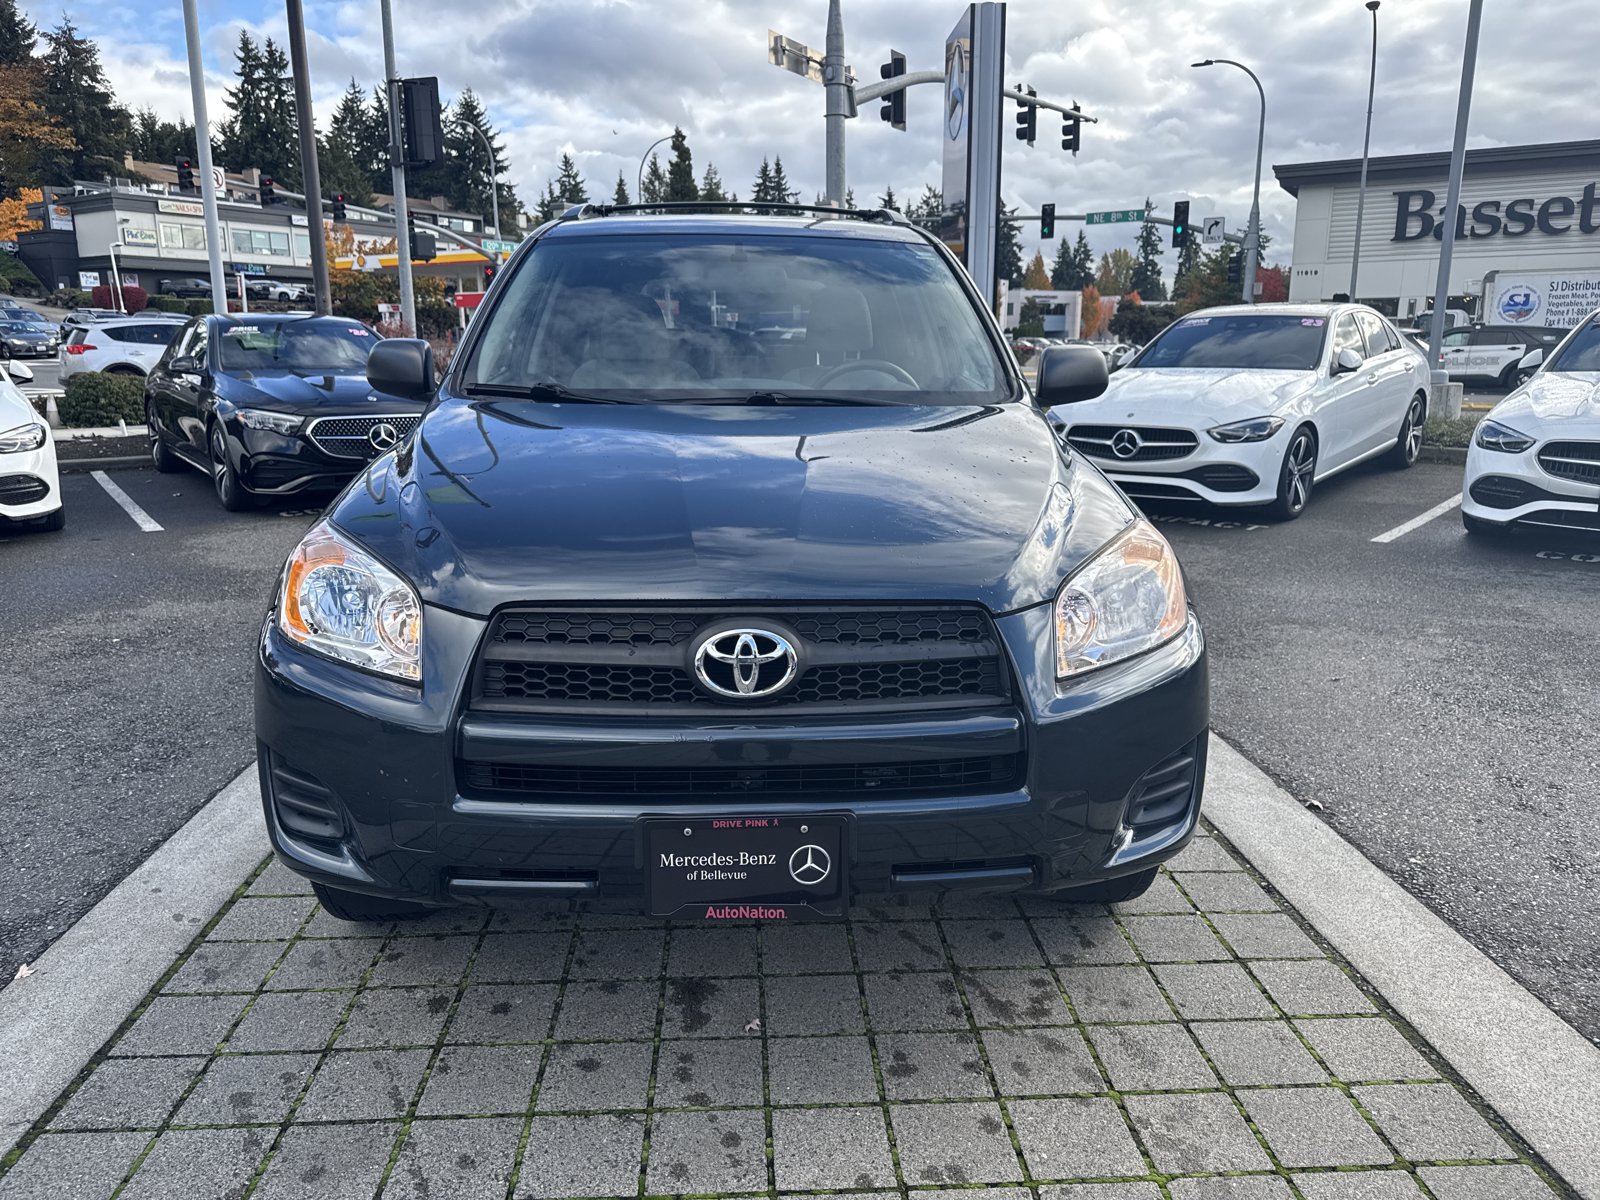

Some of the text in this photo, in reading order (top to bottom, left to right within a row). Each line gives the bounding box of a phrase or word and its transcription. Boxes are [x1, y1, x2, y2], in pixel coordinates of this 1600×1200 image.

[1093, 212, 1137, 223] NE 8th St
[1550, 281, 1559, 291] SJ
[1506, 293, 1530, 307] SJ
[1548, 300, 1584, 308] Vegetables,
[1546, 308, 1565, 316] Phone
[1544, 317, 1555, 326] Fax
[712, 819, 768, 828] DRIVE PINK
[660, 852, 776, 867] Mercedes-Benz
[687, 870, 747, 880] of Bellevue
[705, 906, 785, 919] AutoNation
